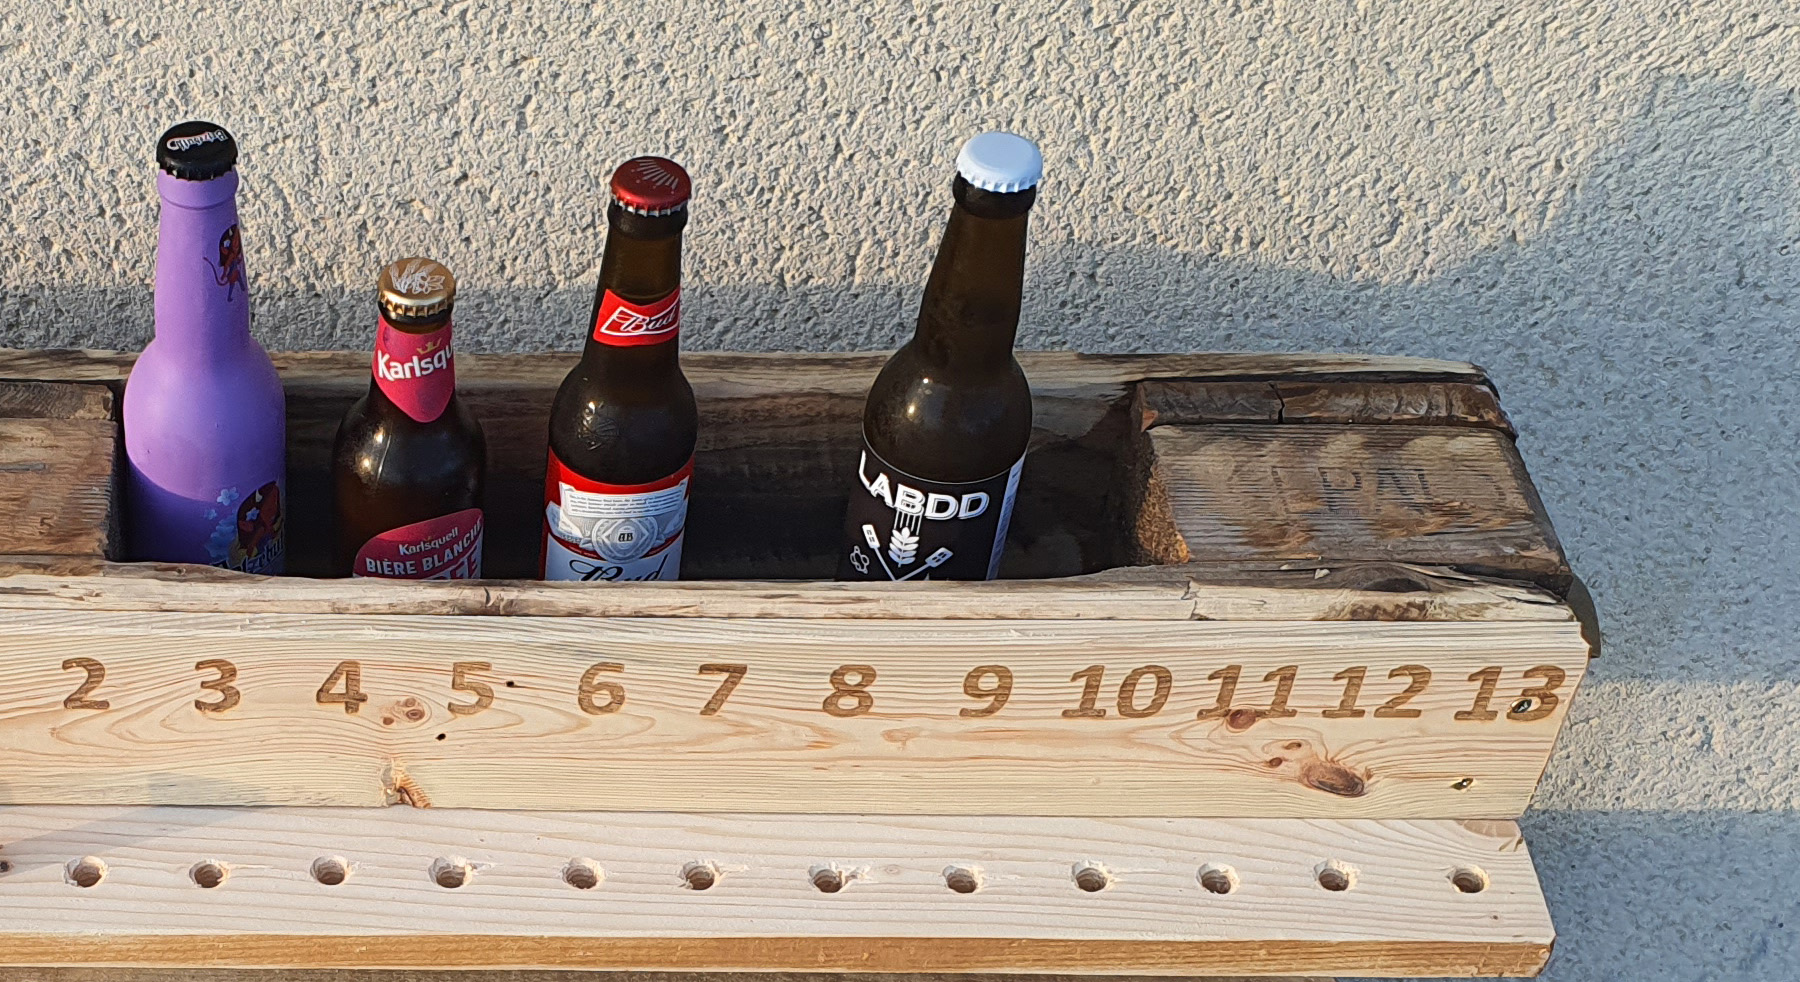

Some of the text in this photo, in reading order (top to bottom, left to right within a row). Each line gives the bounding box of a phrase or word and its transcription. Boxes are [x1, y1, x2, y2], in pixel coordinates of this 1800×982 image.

[615, 306, 676, 333] Bud
[858, 450, 990, 521] LABDD
[398, 526, 459, 556] Karlsquell
[365, 557, 417, 576] BIÈRE
[62, 657, 111, 711] 2
[194, 659, 241, 713] 3
[316, 660, 369, 714] 4
[446, 662, 493, 715] 5
[577, 662, 626, 715] 6
[698, 663, 748, 716] 7
[822, 664, 877, 717] 8
[958, 664, 1014, 718] 9
[1061, 664, 1172, 719] 10
[1197, 664, 1299, 720] 11
[1321, 665, 1432, 719] 12
[1453, 665, 1566, 722] 13
